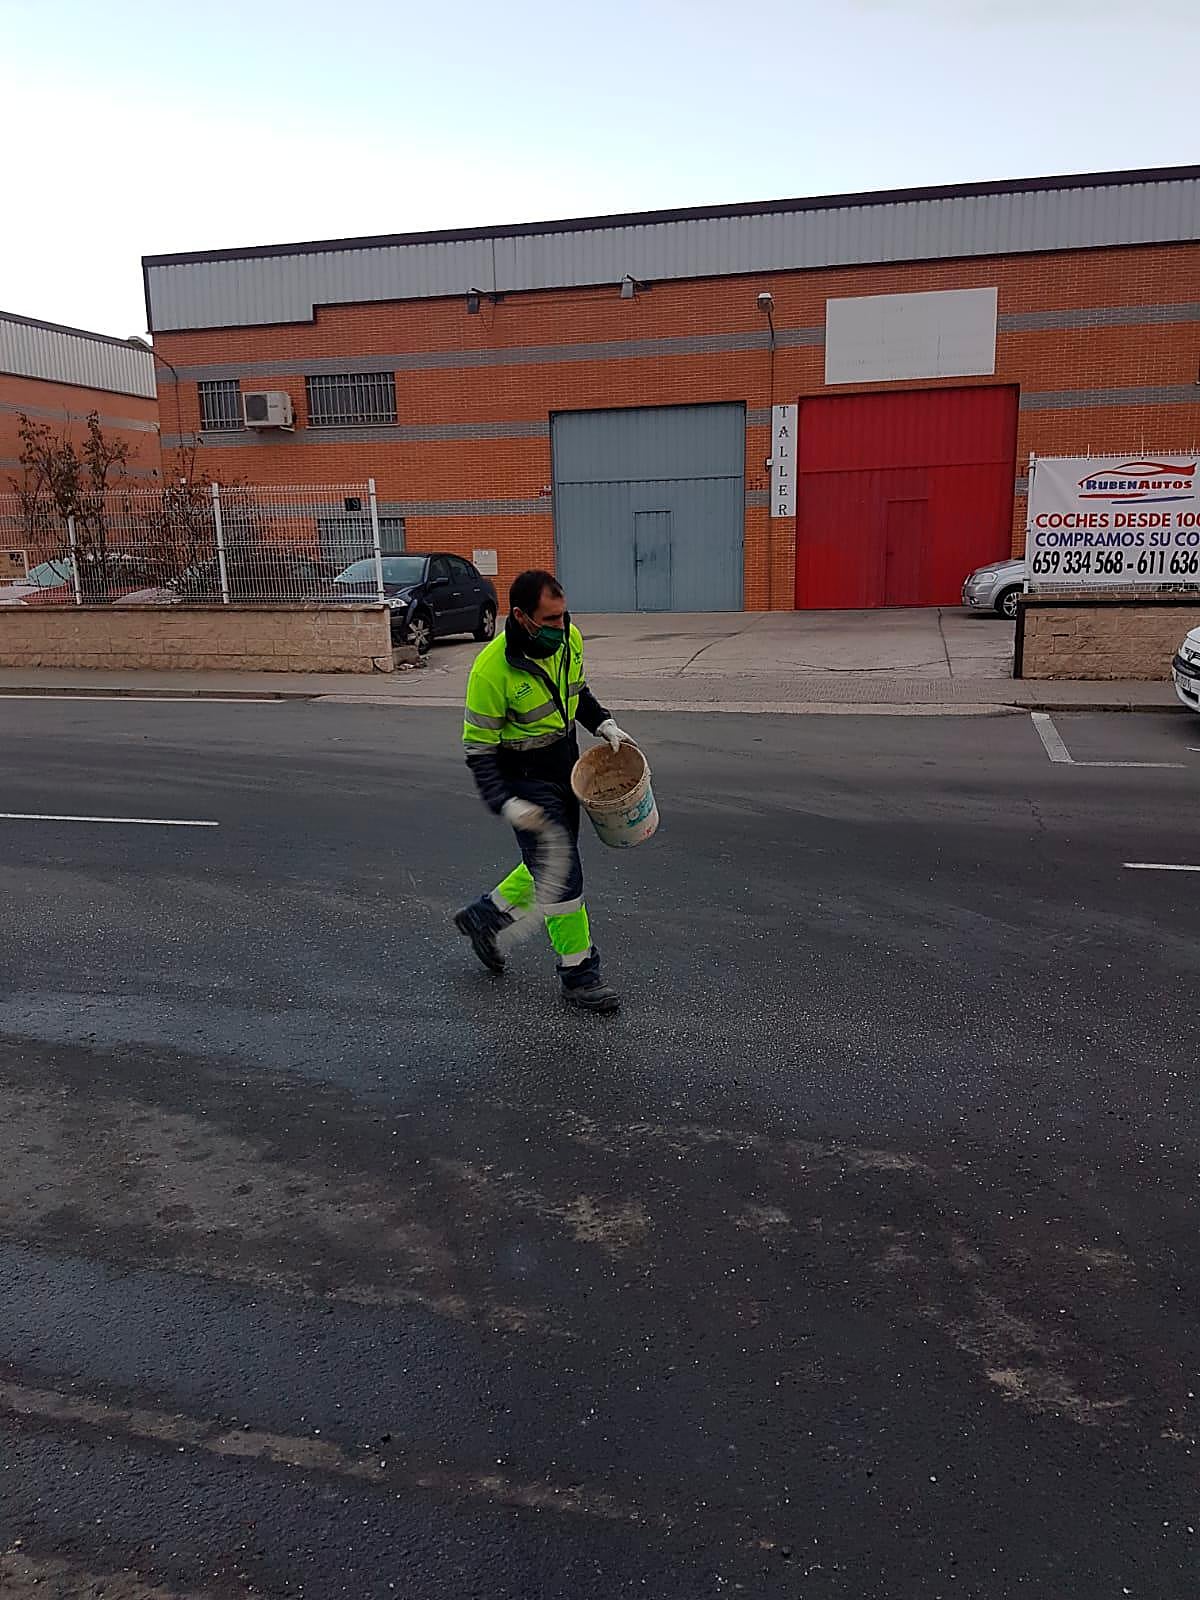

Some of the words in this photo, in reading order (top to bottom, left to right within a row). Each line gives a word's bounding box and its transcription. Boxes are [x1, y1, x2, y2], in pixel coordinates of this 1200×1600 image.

[778, 406, 789, 515] TALLER
[1035, 513, 1109, 528] COCHES
[1114, 513, 1171, 528] DESDE
[1035, 532, 1144, 547] COMPRAMOS
[1149, 532, 1171, 547] SU
[1175, 532, 1200, 547] CO
[1033, 551, 1060, 574] 659
[1063, 551, 1091, 574] 334
[1094, 551, 1123, 574] 568
[1137, 551, 1165, 574] 611
[1170, 551, 1199, 574] 636
